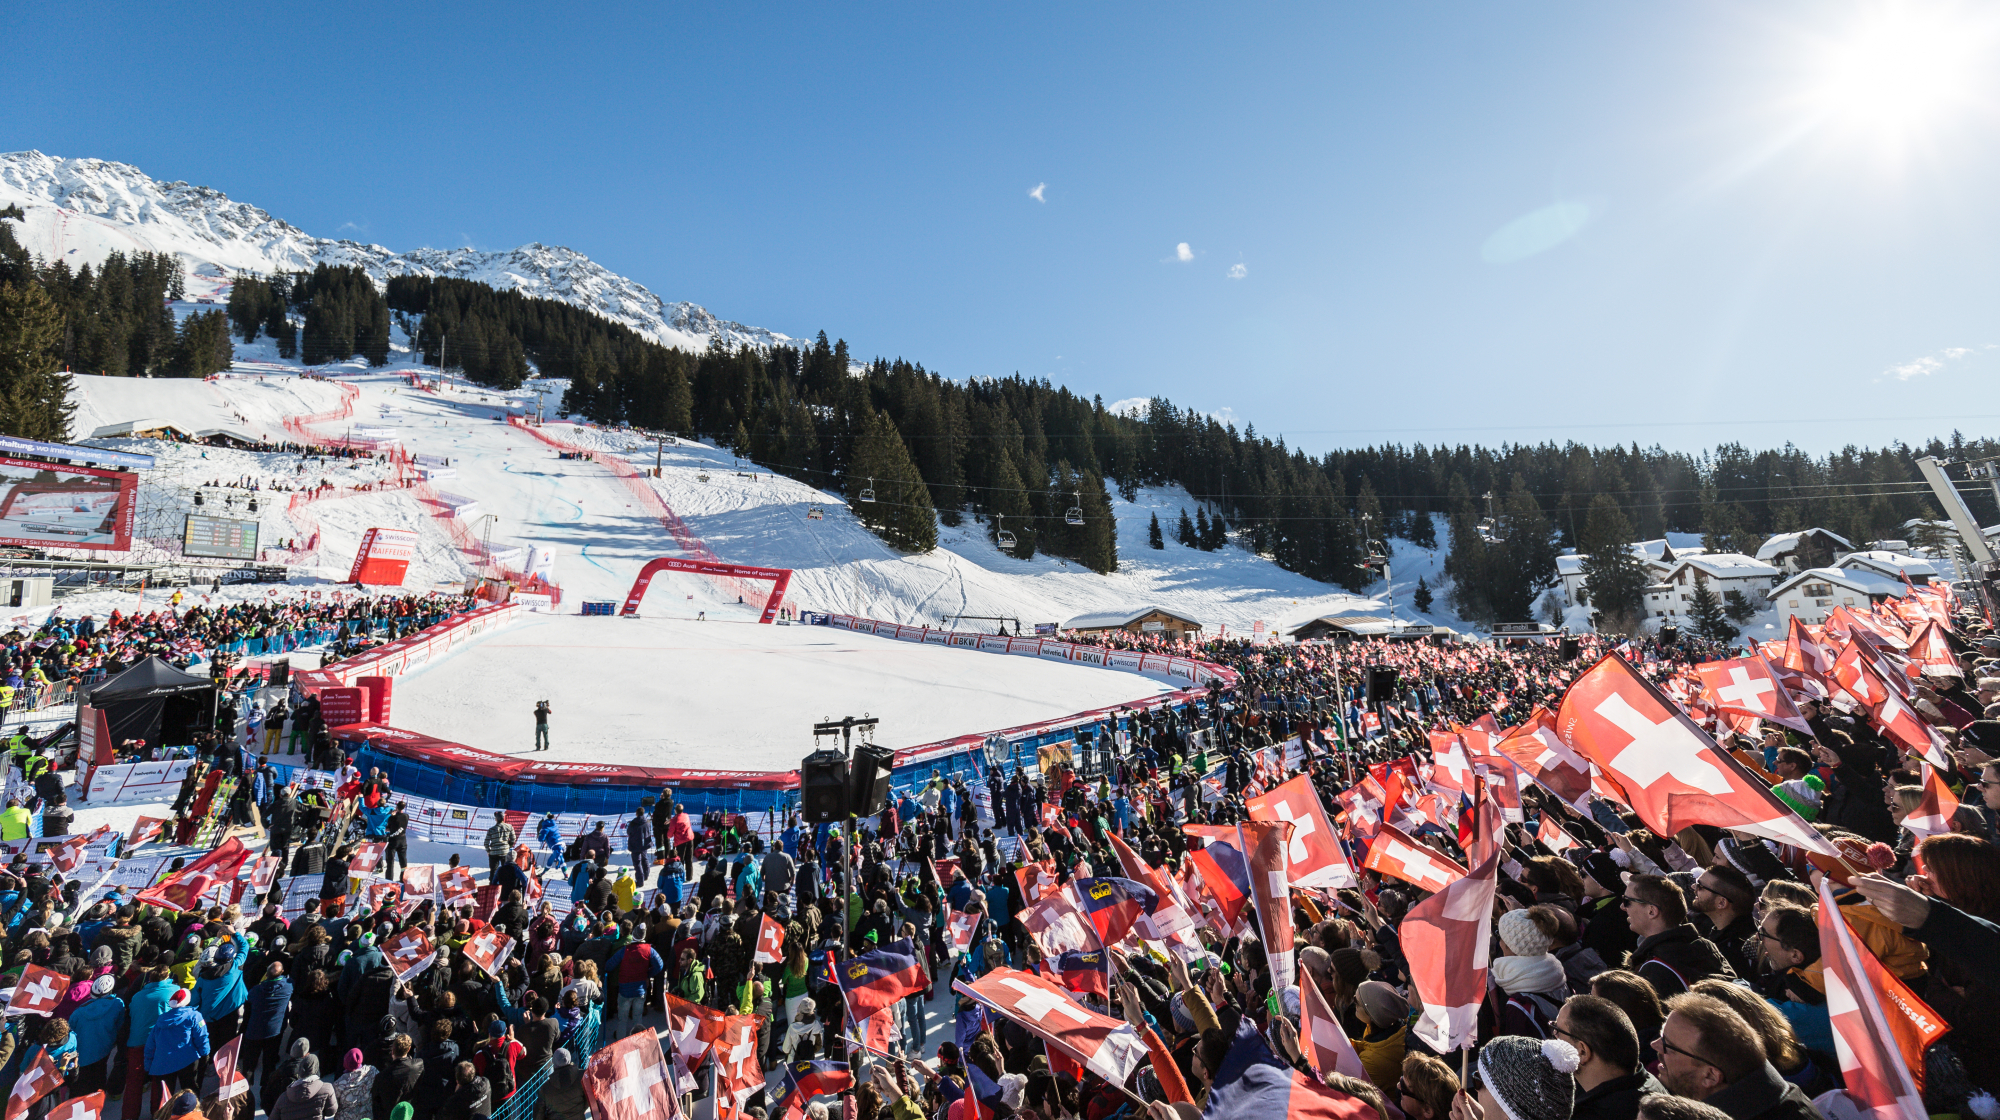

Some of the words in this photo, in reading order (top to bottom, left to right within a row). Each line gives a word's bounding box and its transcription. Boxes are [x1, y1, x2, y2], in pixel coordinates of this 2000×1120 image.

[50, 447, 74, 455] immer
[128, 488, 137, 507] Audi
[124, 508, 133, 537] quattro
[371, 547, 411, 557] RAIFFEISEN
[192, 569, 257, 579] LONGINES
[521, 597, 550, 607] swisscom
[859, 623, 871, 631] BKW
[959, 638, 975, 646] BKW
[1011, 644, 1037, 652] RAIFFEISEN
[1083, 652, 1101, 664] BKW
[1114, 659, 1138, 668] swisscom
[1144, 662, 1167, 673] RAIFFEISEN
[1170, 667, 1186, 678] helvetia
[532, 763, 622, 772] swissski
[129, 866, 149, 874] MSC
[1886, 989, 1936, 1034] swissski
